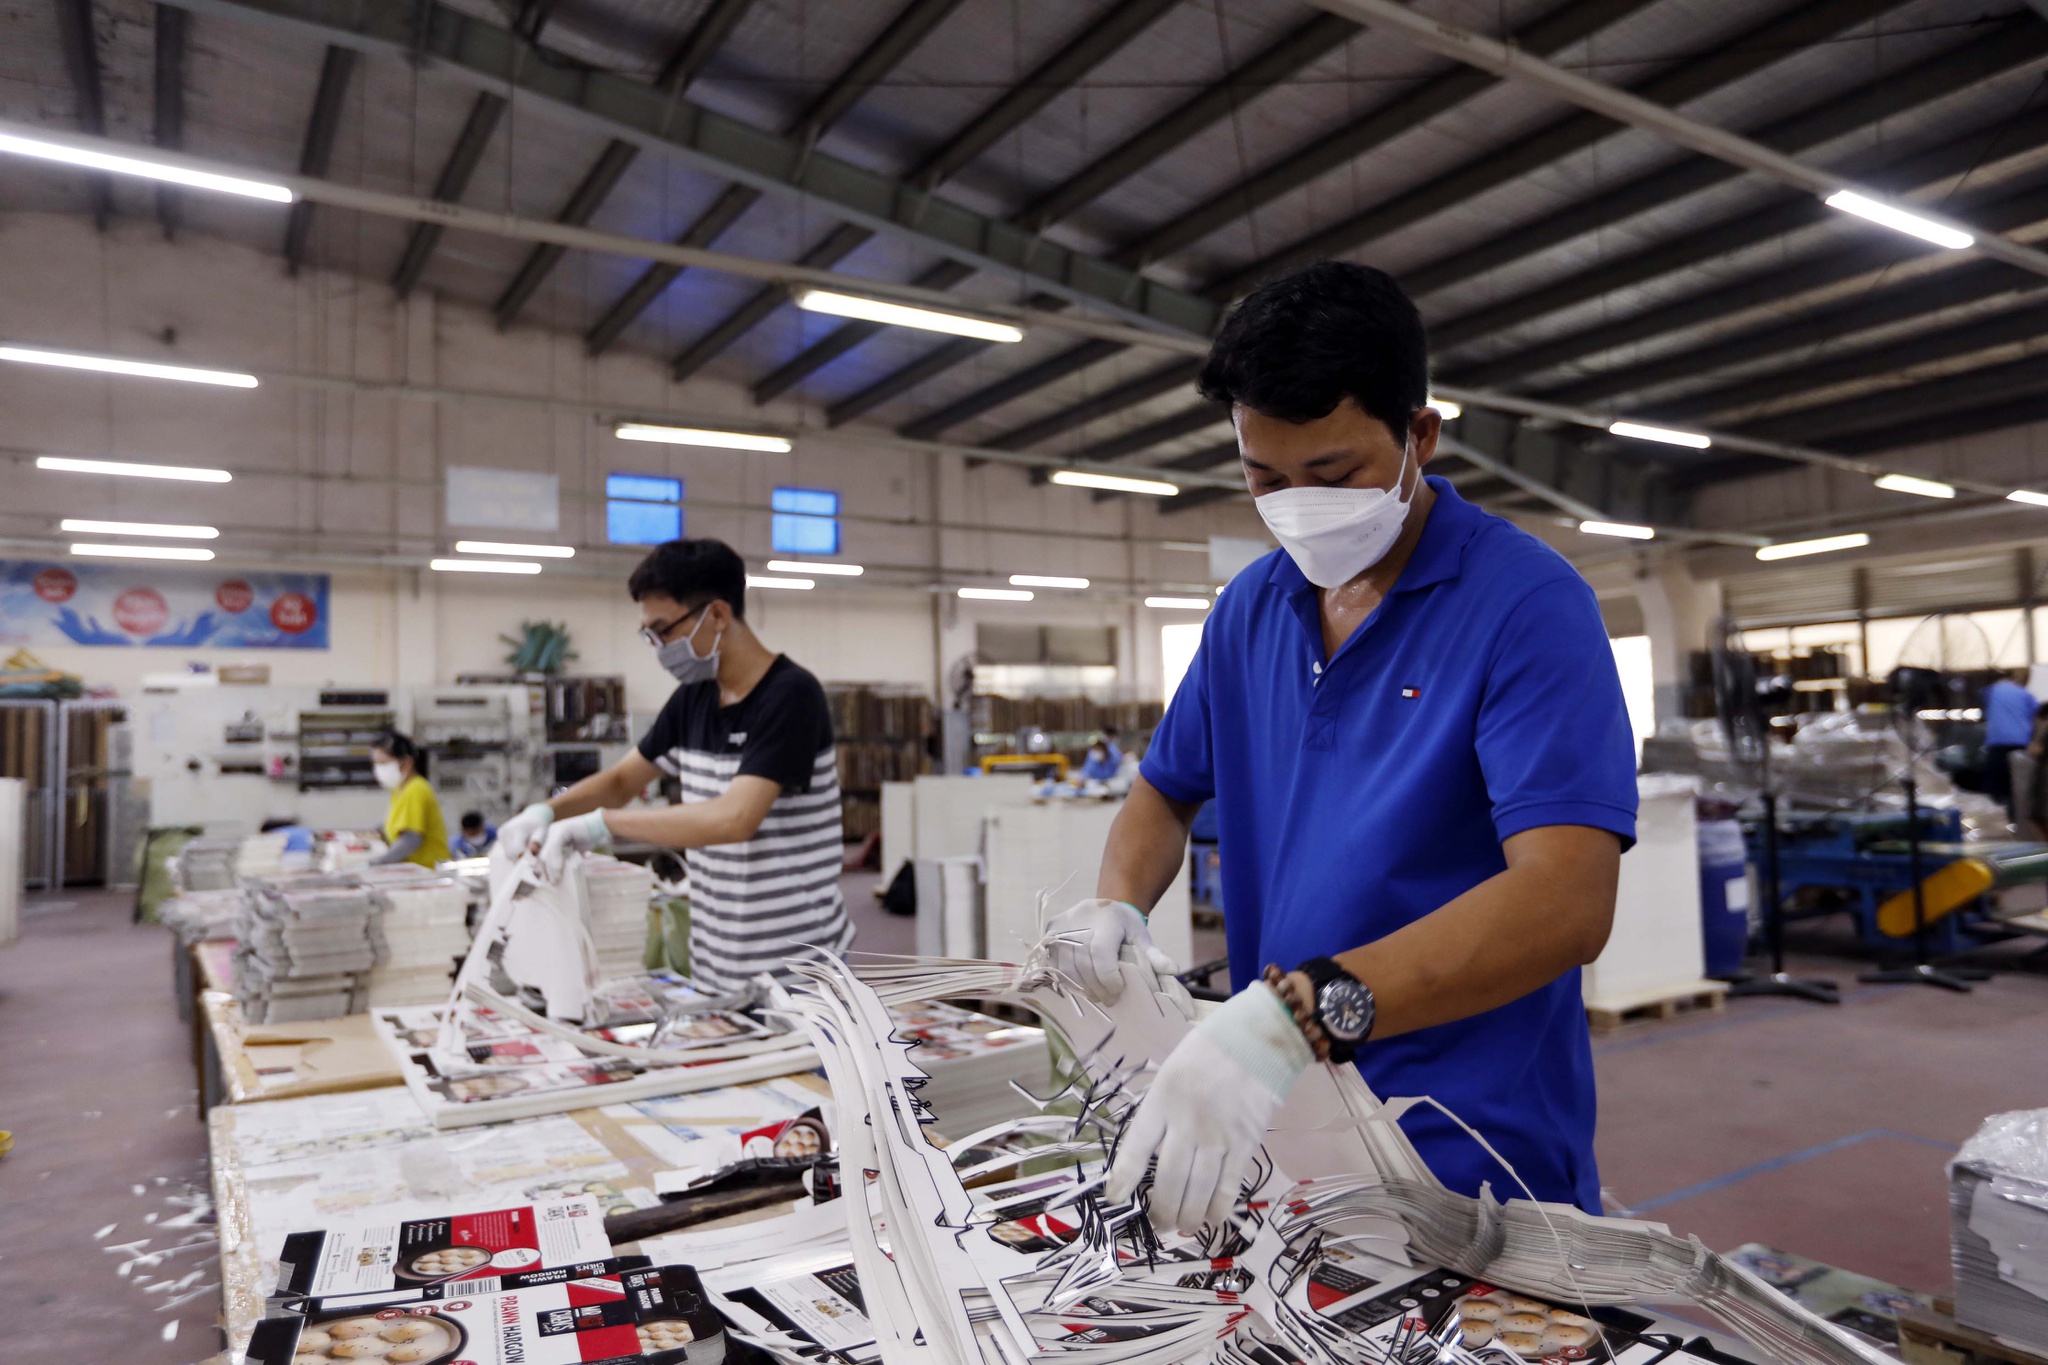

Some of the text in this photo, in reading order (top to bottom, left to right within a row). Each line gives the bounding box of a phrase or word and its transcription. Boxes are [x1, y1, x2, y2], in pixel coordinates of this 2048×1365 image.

[520, 1269, 567, 1280] HARGOW
[529, 1273, 567, 1284] PRAWN
[580, 1305, 602, 1317] MR
[549, 1309, 575, 1332] CHEN'S
[500, 1295, 525, 1364] PRAWN HARGOW
